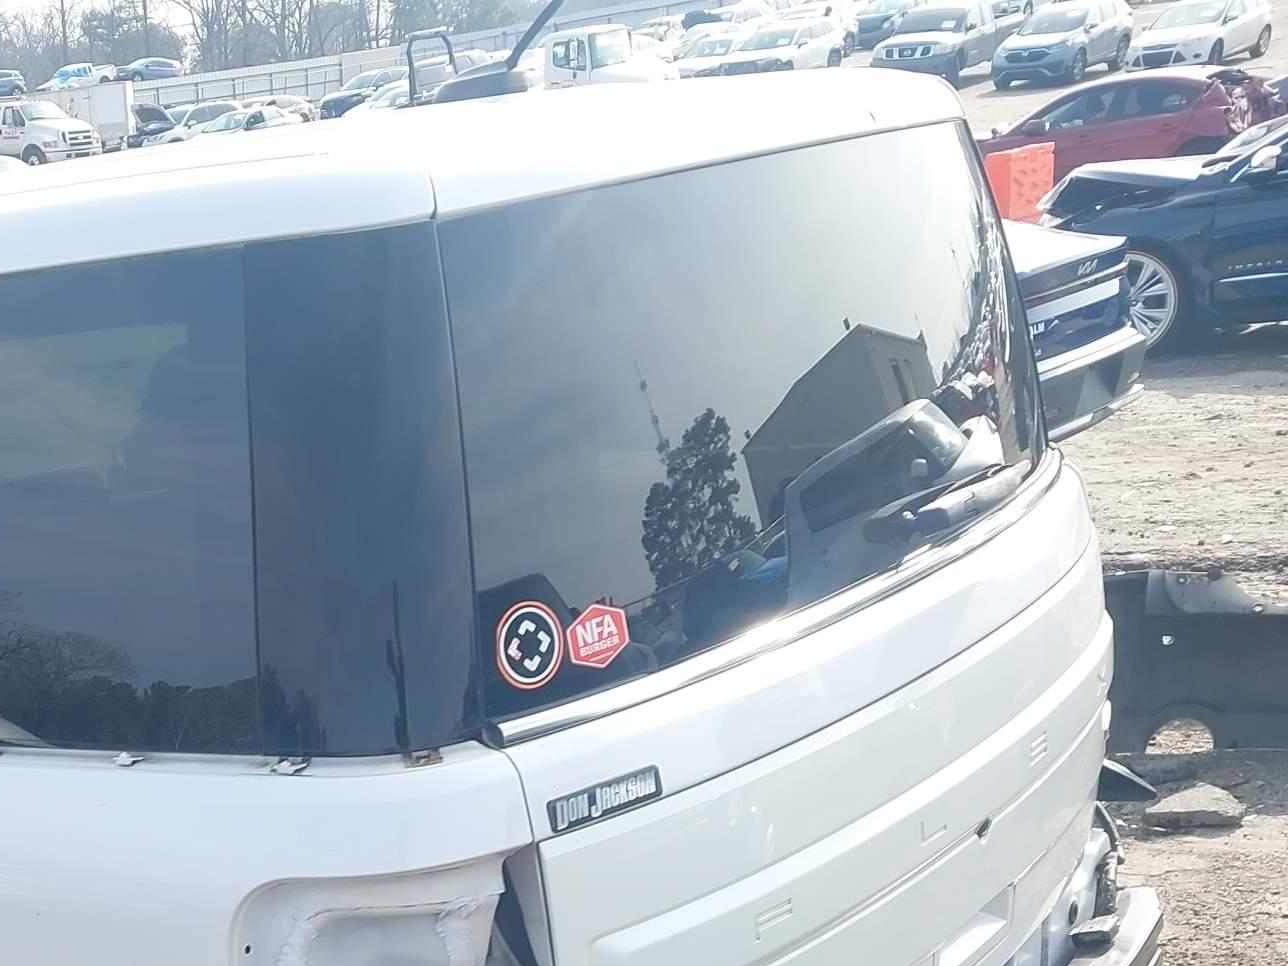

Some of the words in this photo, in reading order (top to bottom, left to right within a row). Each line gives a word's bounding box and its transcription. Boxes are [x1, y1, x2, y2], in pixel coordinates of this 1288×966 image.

[576, 613, 618, 647] NFA
[579, 634, 621, 657] BURGER
[555, 792, 591, 831] DON
[590, 768, 657, 818] JACKSON
